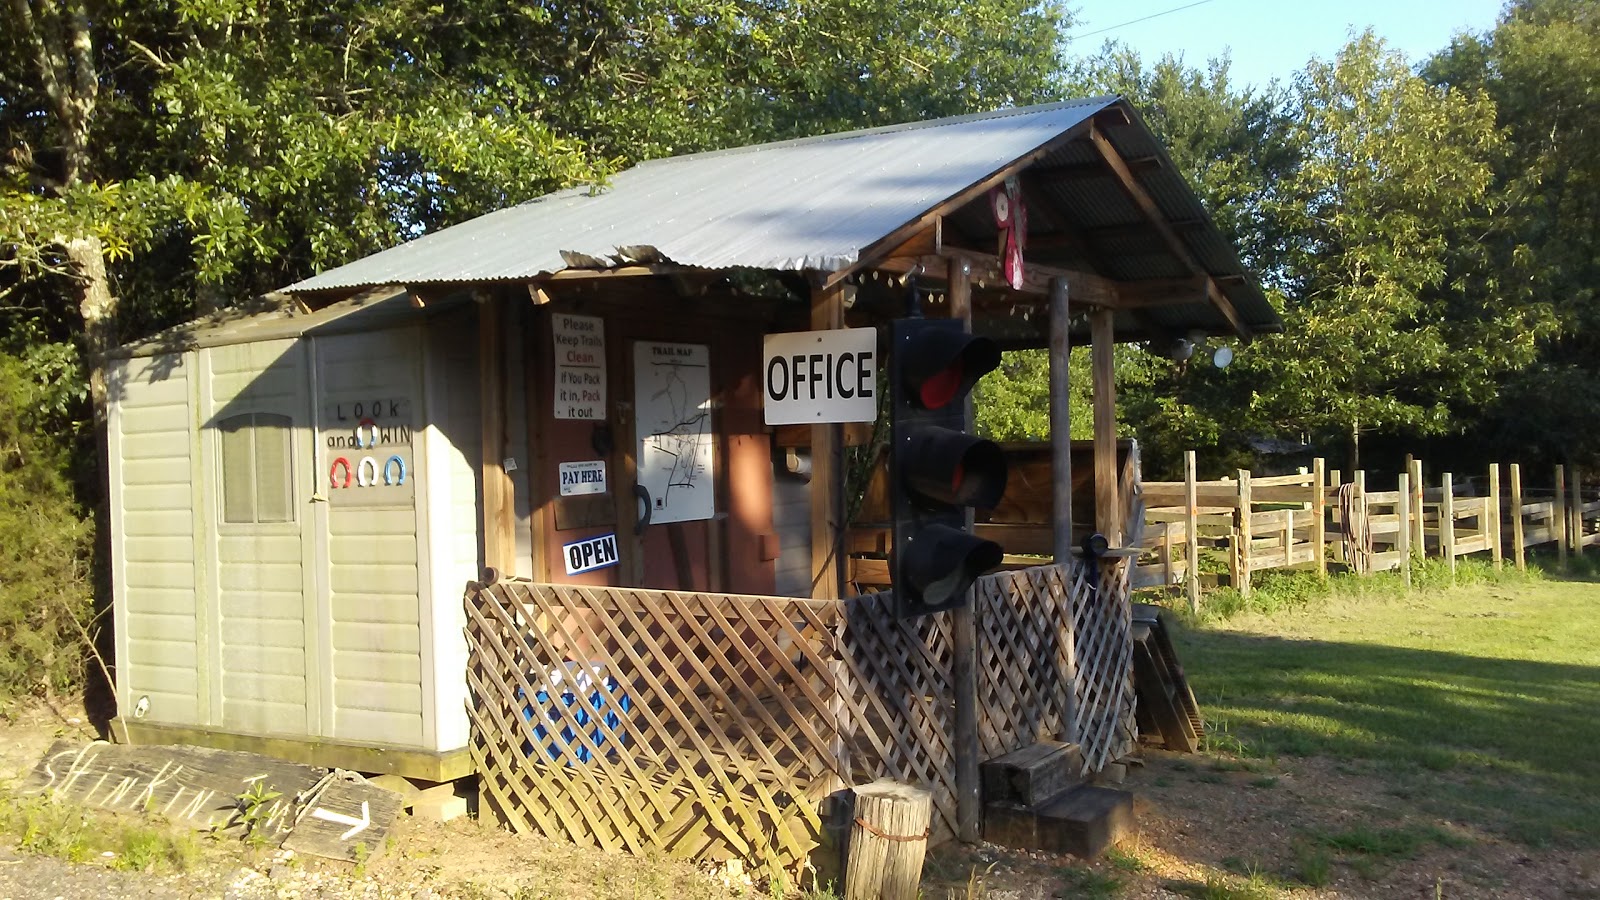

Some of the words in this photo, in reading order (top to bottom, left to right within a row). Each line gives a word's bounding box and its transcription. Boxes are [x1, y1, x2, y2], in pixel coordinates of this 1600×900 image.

[563, 318, 594, 331] Please
[555, 333, 579, 347] Keep
[581, 335, 603, 346] Trails
[567, 351, 594, 363] Clean
[652, 346, 674, 356] TRAIL
[676, 347, 692, 357] MAP
[561, 372, 567, 383] If
[569, 373, 582, 385] You
[584, 373, 601, 385] Pack
[767, 352, 873, 401] OFFICE
[560, 390, 566, 401] it
[569, 390, 580, 403] in,
[582, 390, 601, 402] Pack
[568, 406, 575, 417] it
[577, 408, 593, 417] out
[327, 428, 357, 448] and
[380, 424, 411, 444] WIN
[562, 471, 580, 484] PAY
[581, 469, 604, 483] HERE
[569, 537, 616, 570] OPEN
